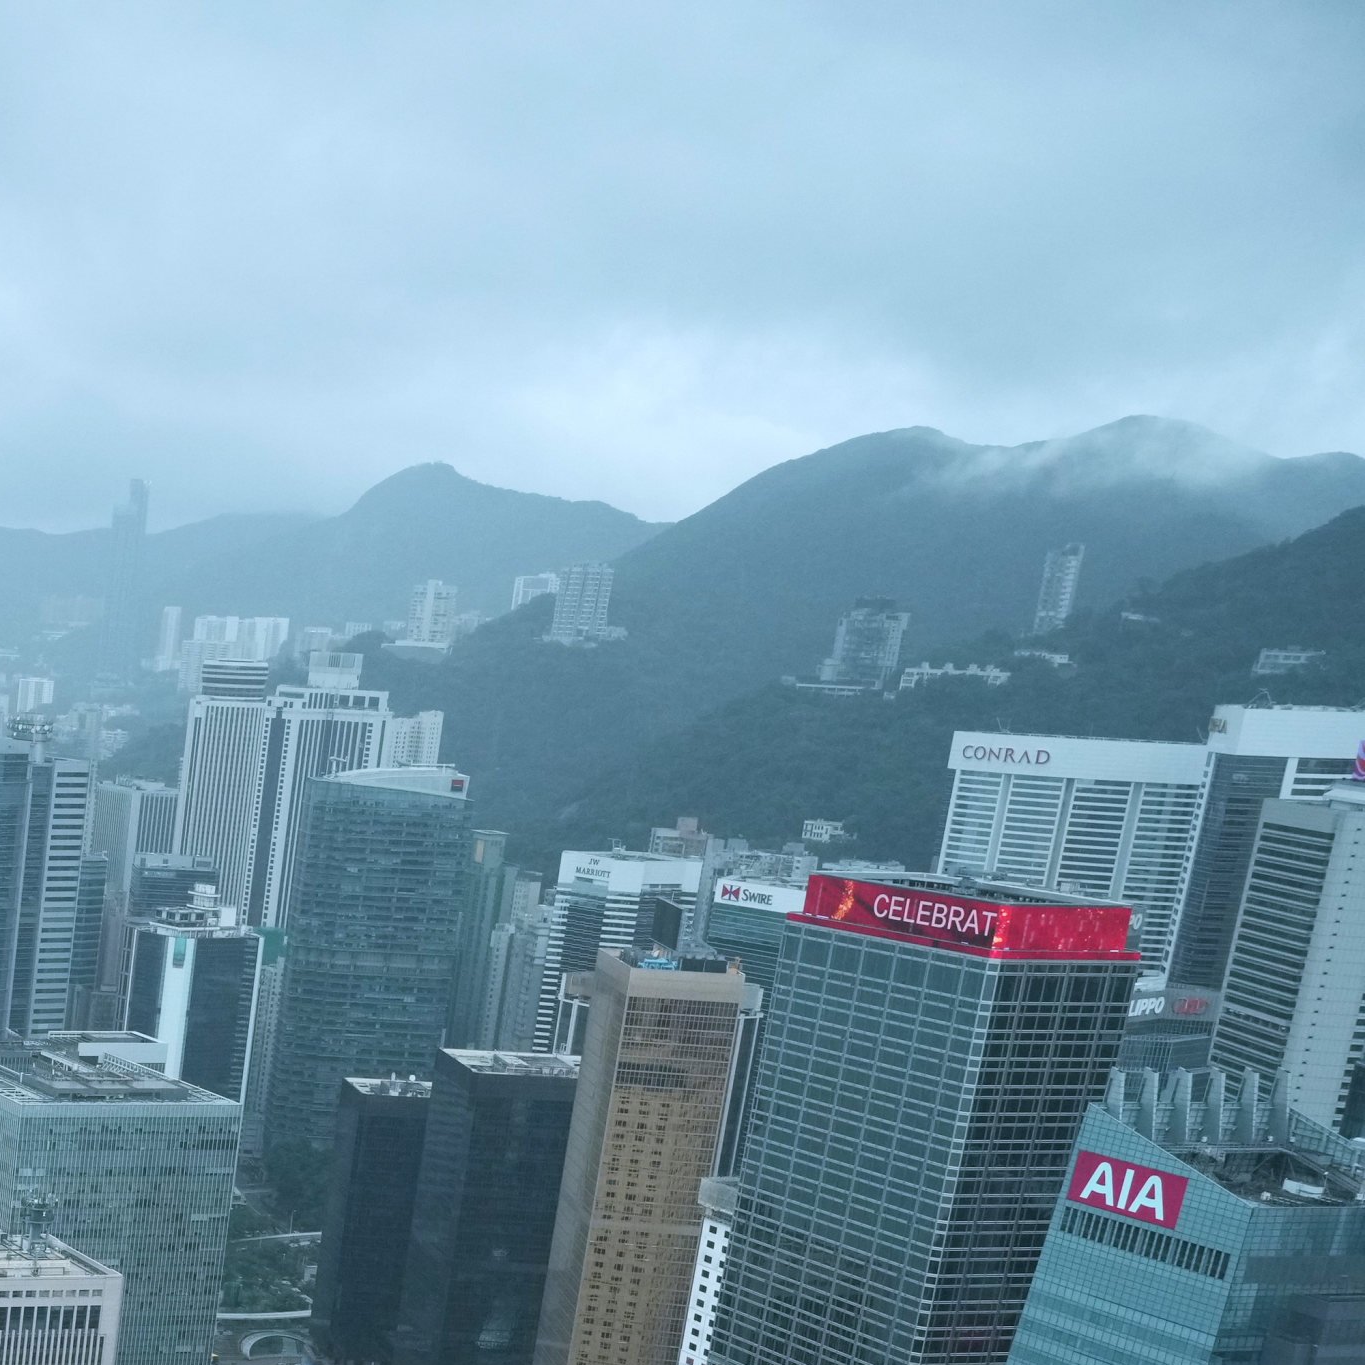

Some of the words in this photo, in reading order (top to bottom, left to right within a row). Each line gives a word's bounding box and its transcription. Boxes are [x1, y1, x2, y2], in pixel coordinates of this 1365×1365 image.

[962, 745, 1051, 765] CONRAD
[575, 866, 611, 878] MARRIOTT
[588, 858, 600, 866] JW
[873, 893, 998, 937] CELEBRAT
[1128, 997, 1165, 1017] LIPPO
[1079, 1161, 1164, 1221] AIA
